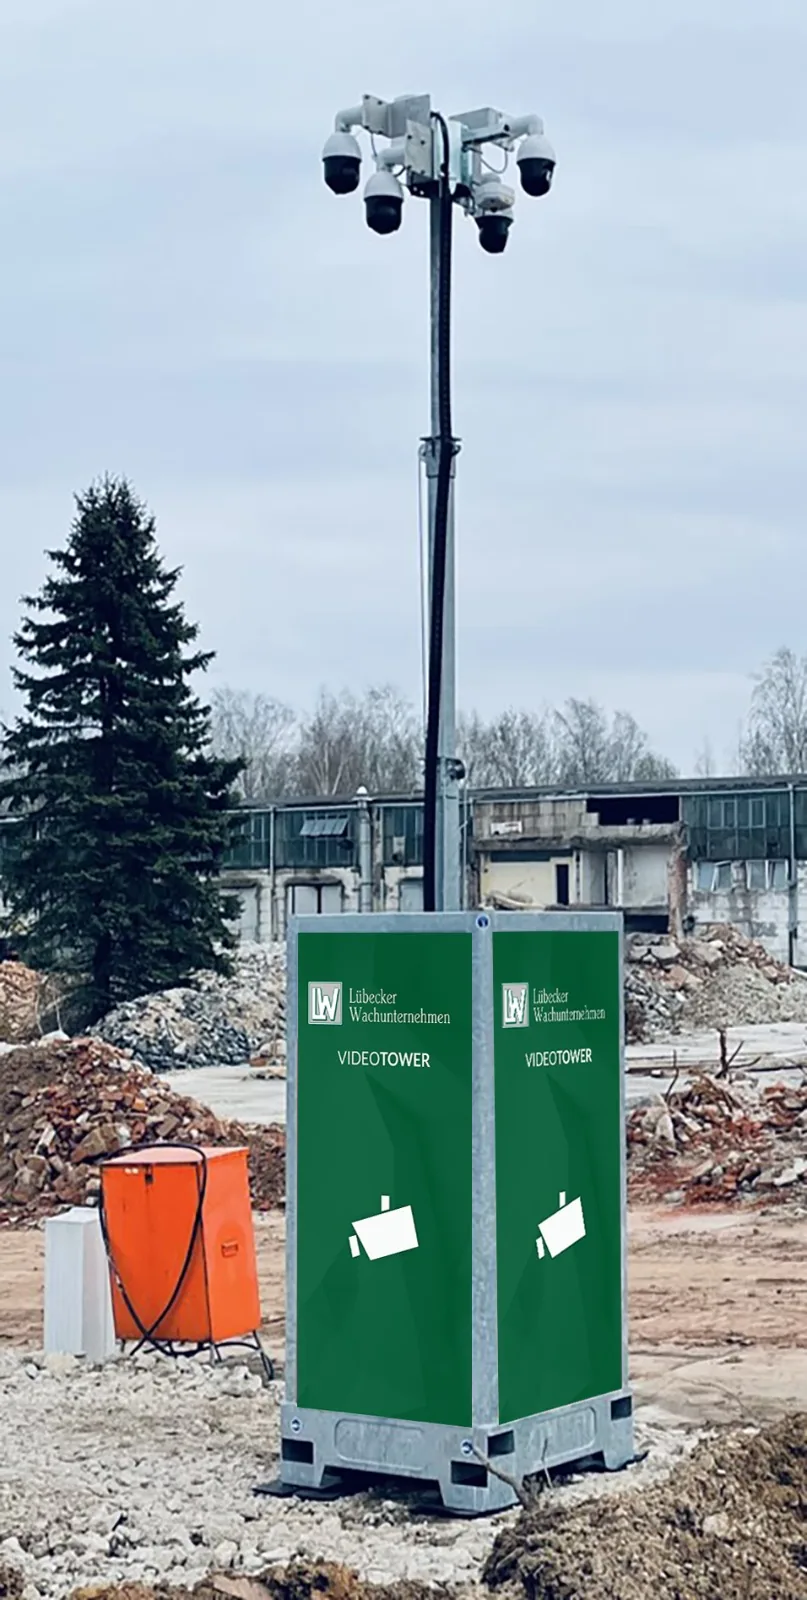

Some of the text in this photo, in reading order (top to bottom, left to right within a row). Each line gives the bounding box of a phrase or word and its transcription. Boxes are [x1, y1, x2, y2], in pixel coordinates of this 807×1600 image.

[349, 987, 397, 1004] Lübecker
[533, 987, 569, 1004] Lübecker
[349, 1006, 451, 1024] Wachunternehmen
[533, 1004, 606, 1023] Wachunternehmen
[337, 1050, 431, 1068] VIDEOTOWER
[525, 1047, 593, 1068] VIDEOTOWER
